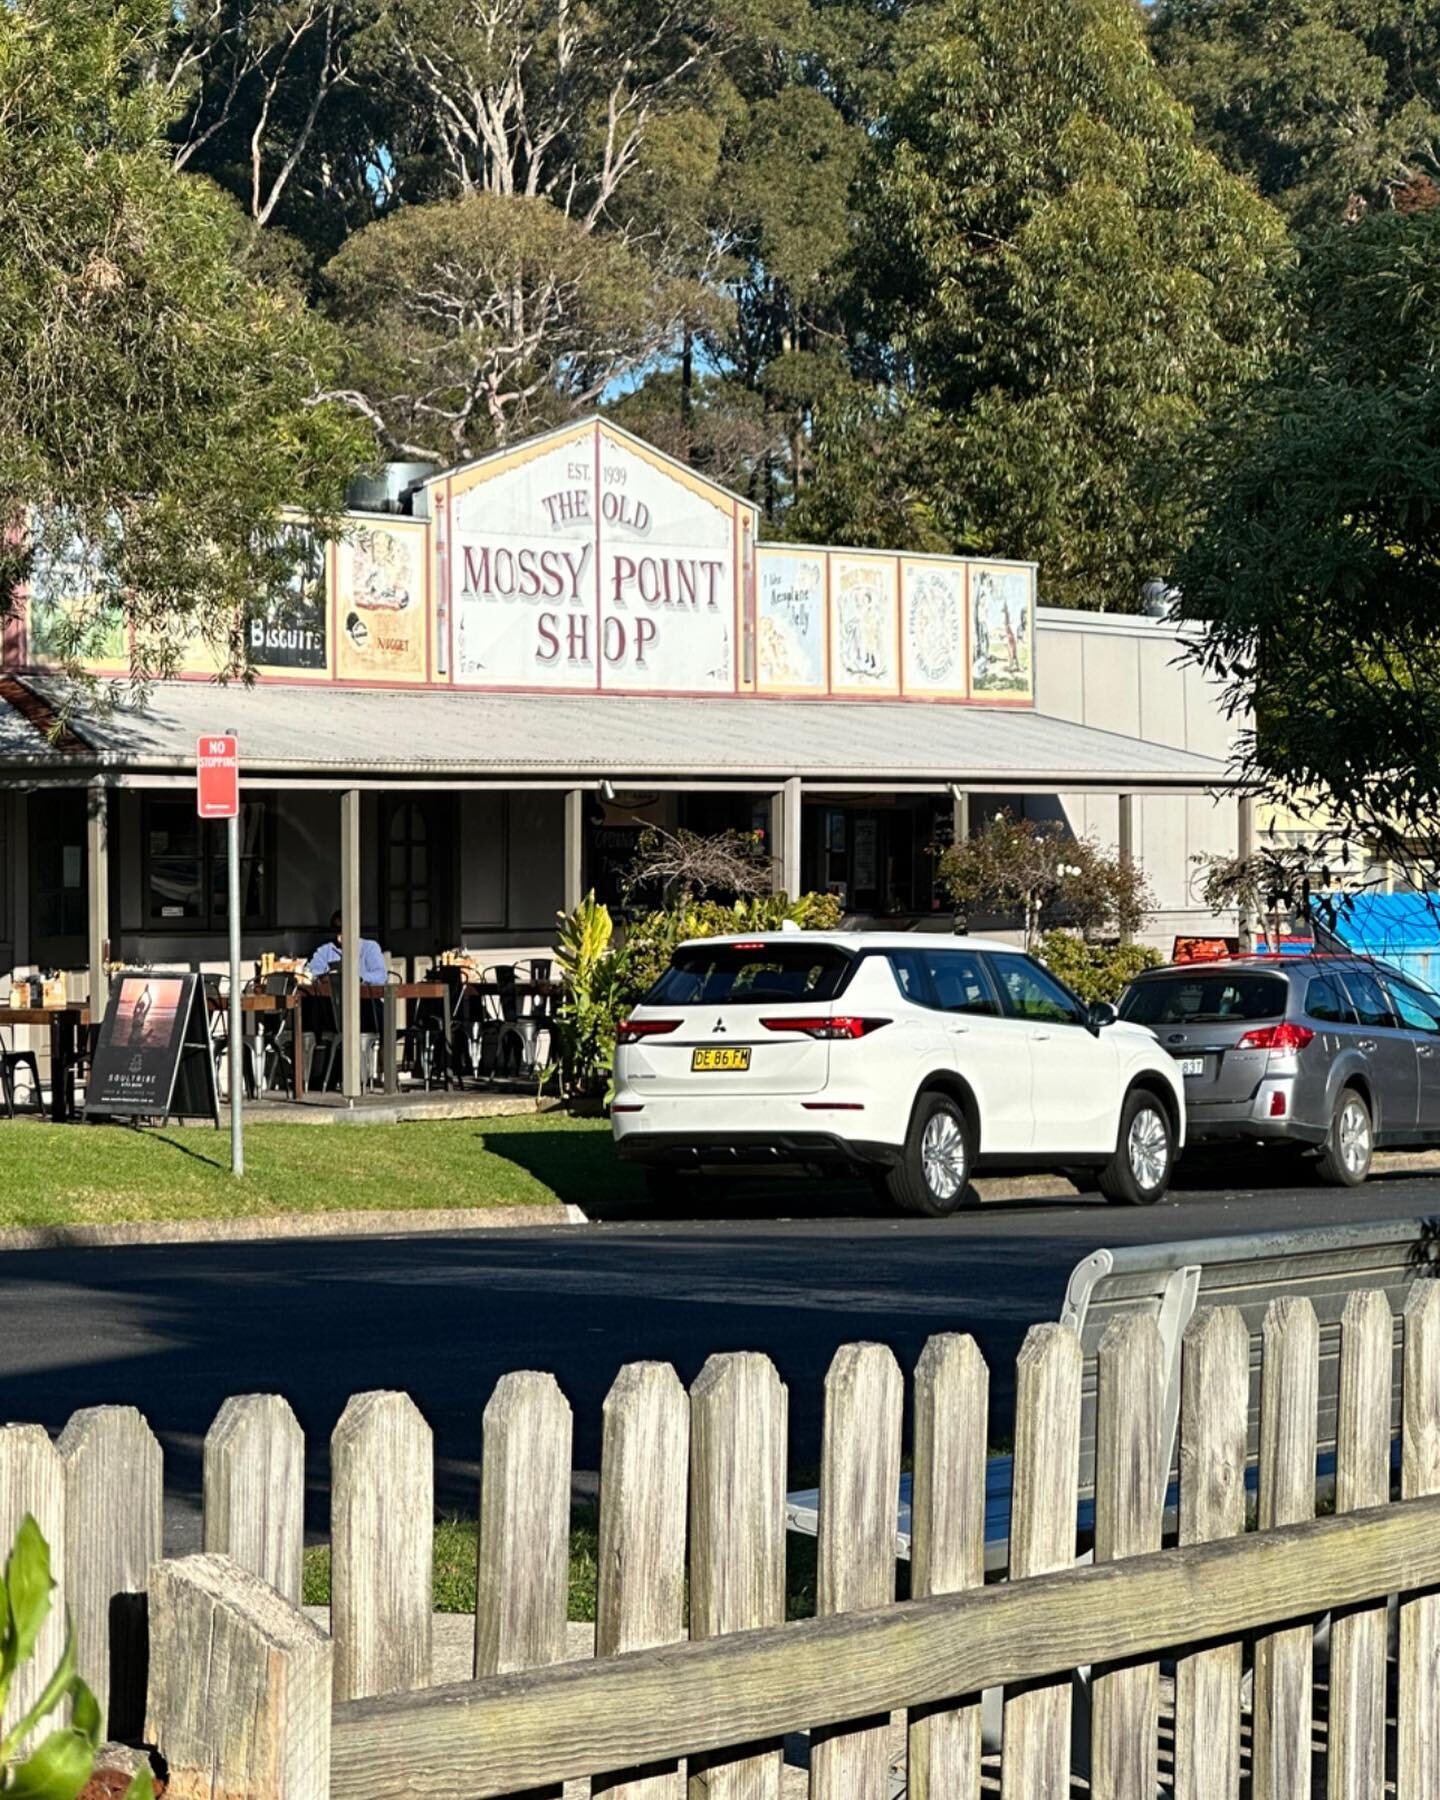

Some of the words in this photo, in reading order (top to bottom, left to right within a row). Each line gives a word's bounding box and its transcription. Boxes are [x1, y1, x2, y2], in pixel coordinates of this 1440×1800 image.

[567, 463, 592, 482] EST.
[603, 465, 628, 484] 1939
[541, 489, 593, 530] THE
[601, 491, 651, 534] OLD
[461, 541, 593, 604] MOSSY
[610, 555, 726, 612] POINT
[535, 611, 660, 670] SHOP
[208, 740, 226, 754] NO
[199, 756, 236, 769] STOPPING
[695, 1050, 711, 1066] DE
[714, 1050, 730, 1066] 86
[732, 1049, 749, 1066] FM
